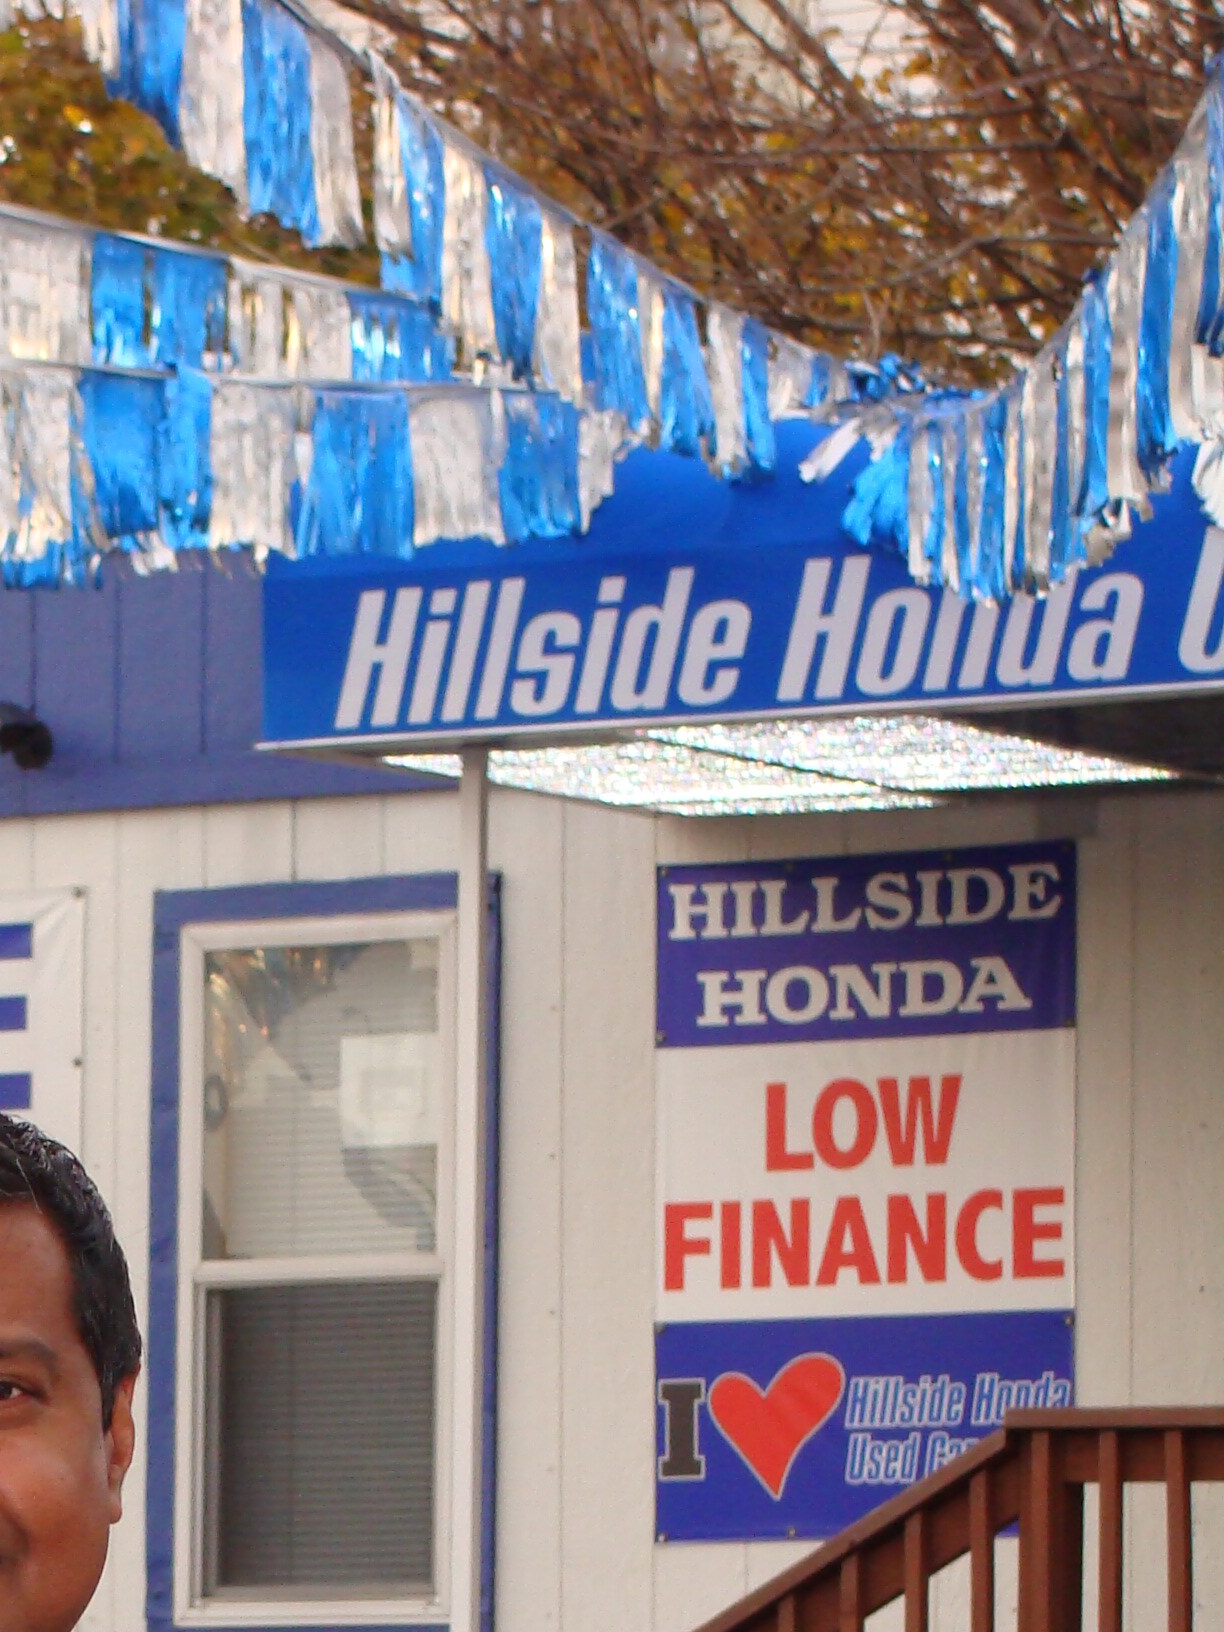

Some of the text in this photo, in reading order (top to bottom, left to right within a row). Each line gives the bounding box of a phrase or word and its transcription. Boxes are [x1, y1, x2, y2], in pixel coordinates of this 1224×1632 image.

[334, 566, 752, 730] Hillside
[777, 554, 1146, 702] Honda
[668, 862, 1063, 940] HILLSIDE
[696, 955, 1033, 1027] HONDA
[765, 1073, 963, 1173] LOW
[663, 1186, 1066, 1292] FINANCE
[658, 1371, 1072, 1481] I Hillside Honda
[845, 1431, 921, 1485] Used
